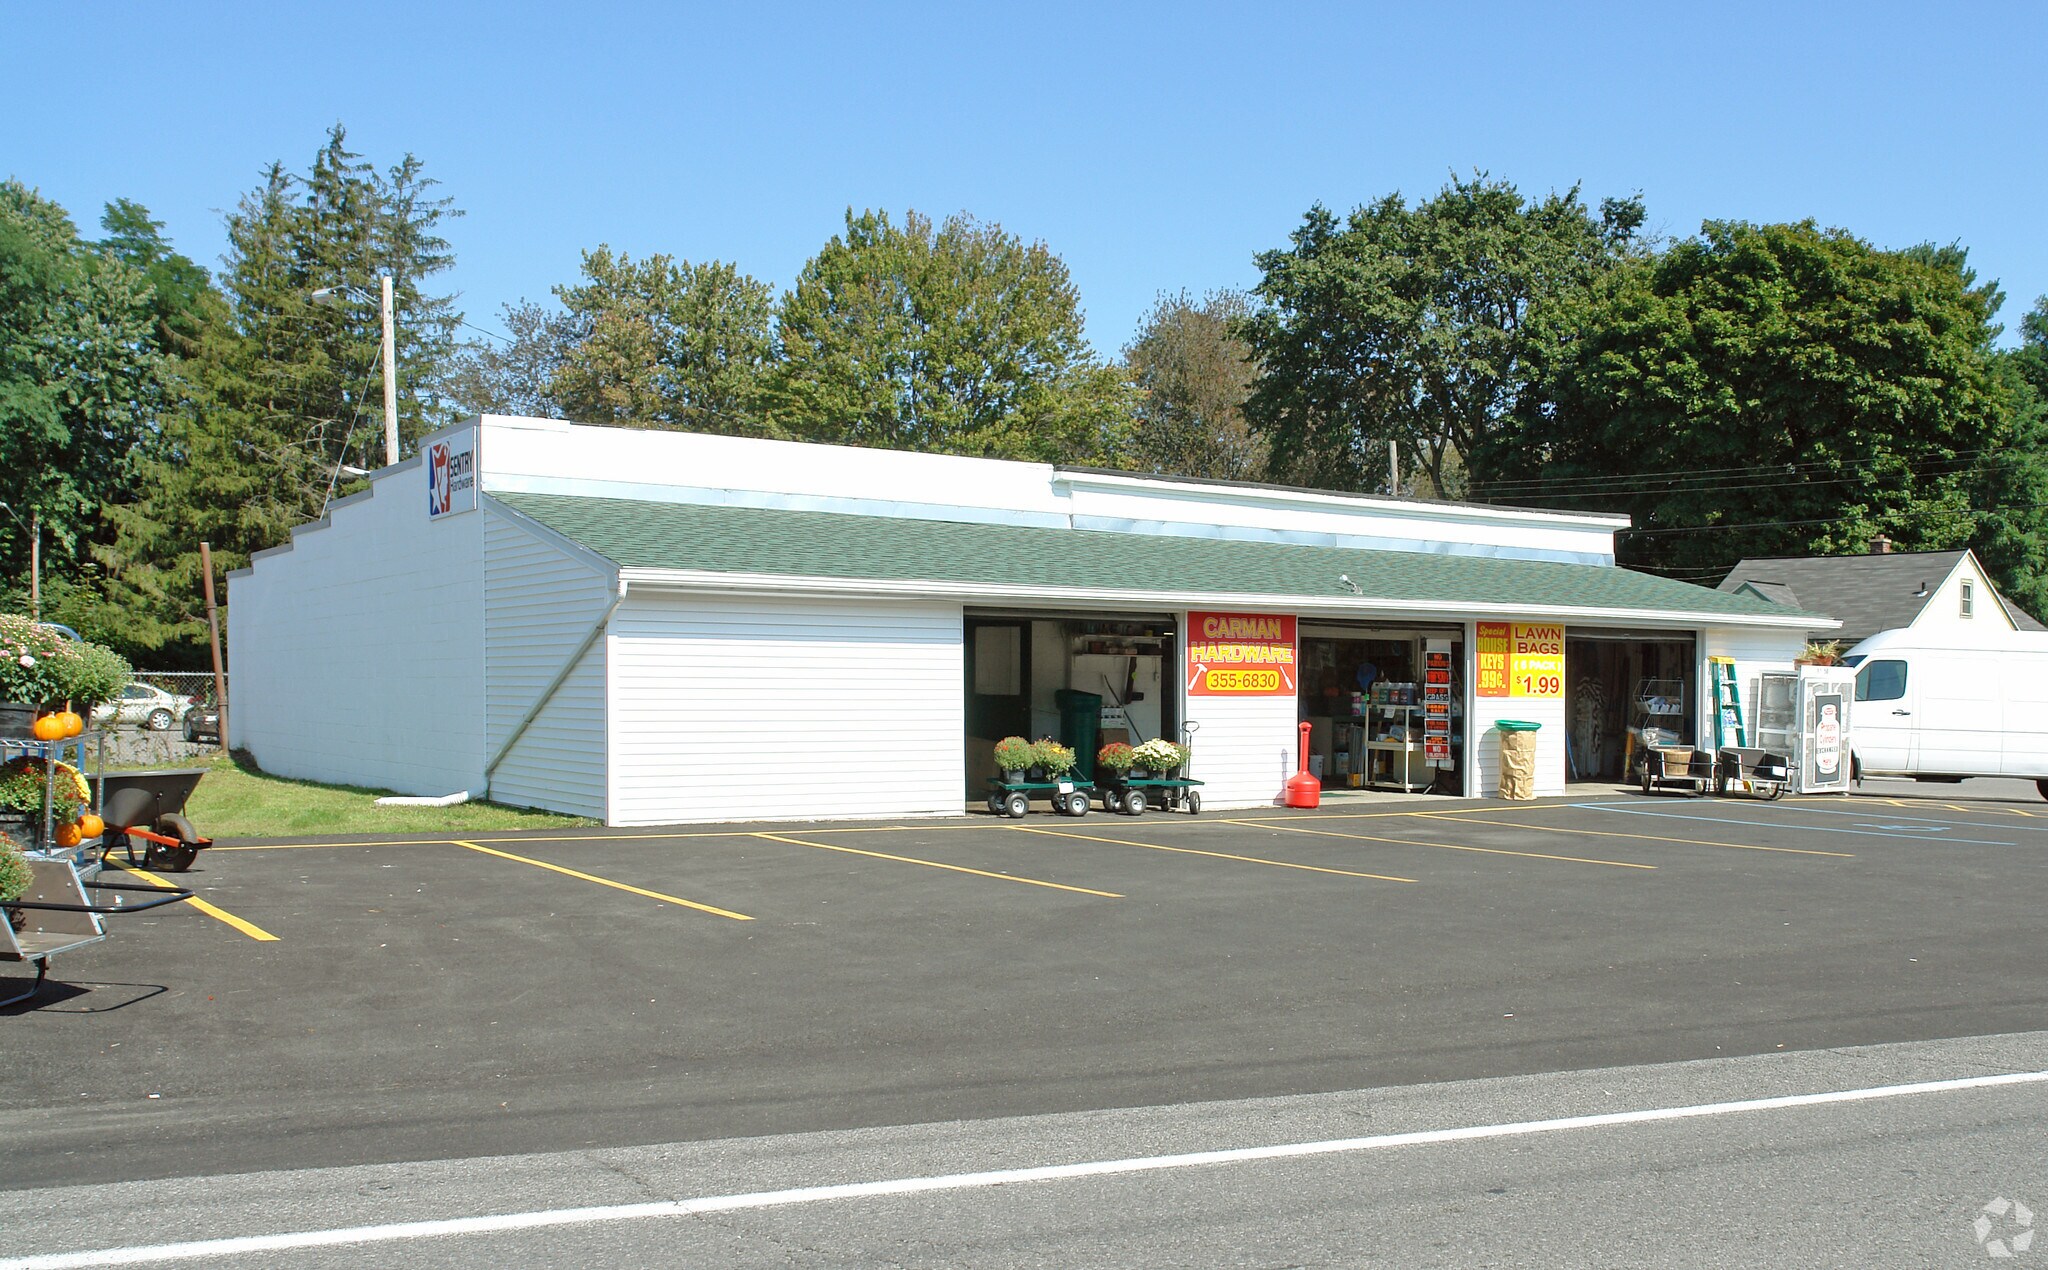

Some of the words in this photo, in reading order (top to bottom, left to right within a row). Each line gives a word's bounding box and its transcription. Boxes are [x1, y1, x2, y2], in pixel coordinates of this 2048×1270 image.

[450, 449, 474, 477] SENTRY
[1203, 617, 1281, 639] CARMAN
[1479, 625, 1506, 636] Special
[1515, 627, 1561, 640] LAWN
[1477, 637, 1508, 652] HOUSE
[1517, 642, 1560, 655] BAGS
[1191, 642, 1293, 664] HARDWARE
[1480, 653, 1504, 670] KEYS
[1210, 673, 1276, 688] 355-6830
